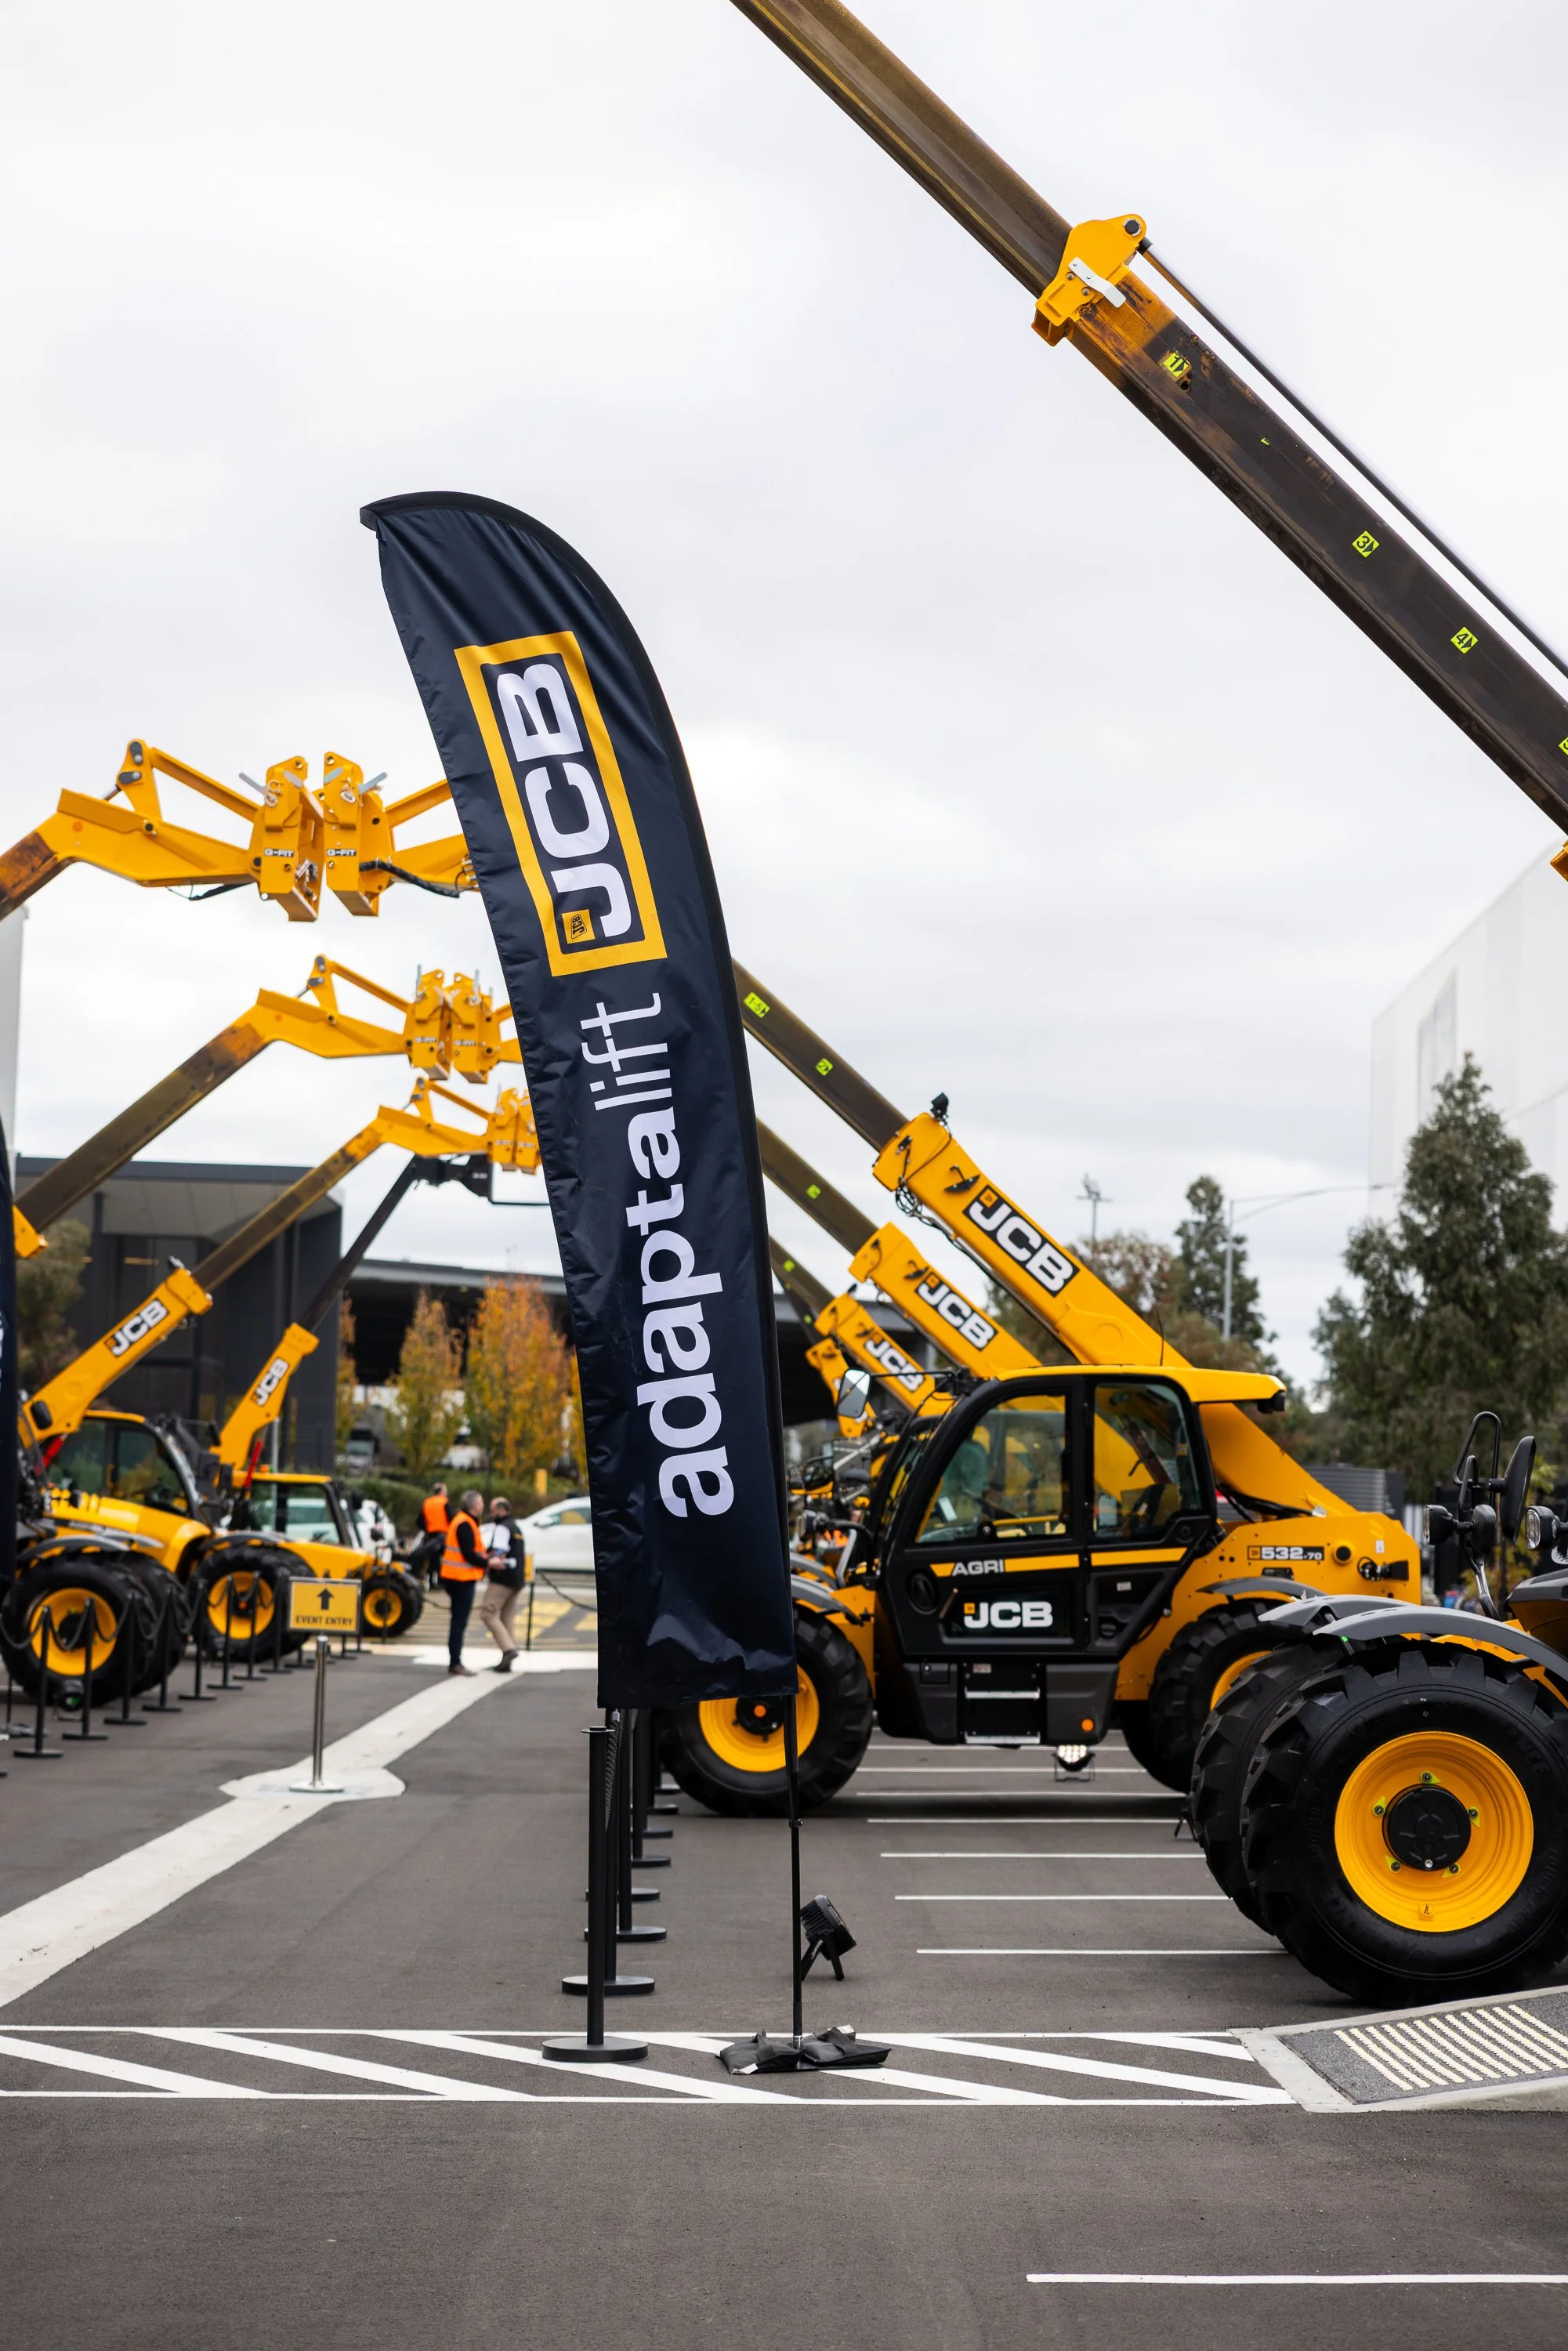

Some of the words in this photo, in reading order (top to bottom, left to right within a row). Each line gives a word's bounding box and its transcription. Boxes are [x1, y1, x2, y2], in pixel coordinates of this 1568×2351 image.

[1356, 535, 1371, 549] 3
[1455, 632, 1469, 646] 4
[497, 664, 632, 937] JCB
[572, 915, 586, 936] JCB
[581, 992, 734, 1518] adaptalift
[969, 1201, 1074, 1291] JCB
[111, 1299, 169, 1357] JCB
[917, 1282, 995, 1349] JCB
[254, 1357, 289, 1407] JCB
[864, 1339, 925, 1392] JCB
[951, 1559, 1005, 1577] AGRI
[295, 1615, 323, 1625] EVENT
[325, 1616, 353, 1626] ENTRY
[963, 1601, 1053, 1629] JCB
